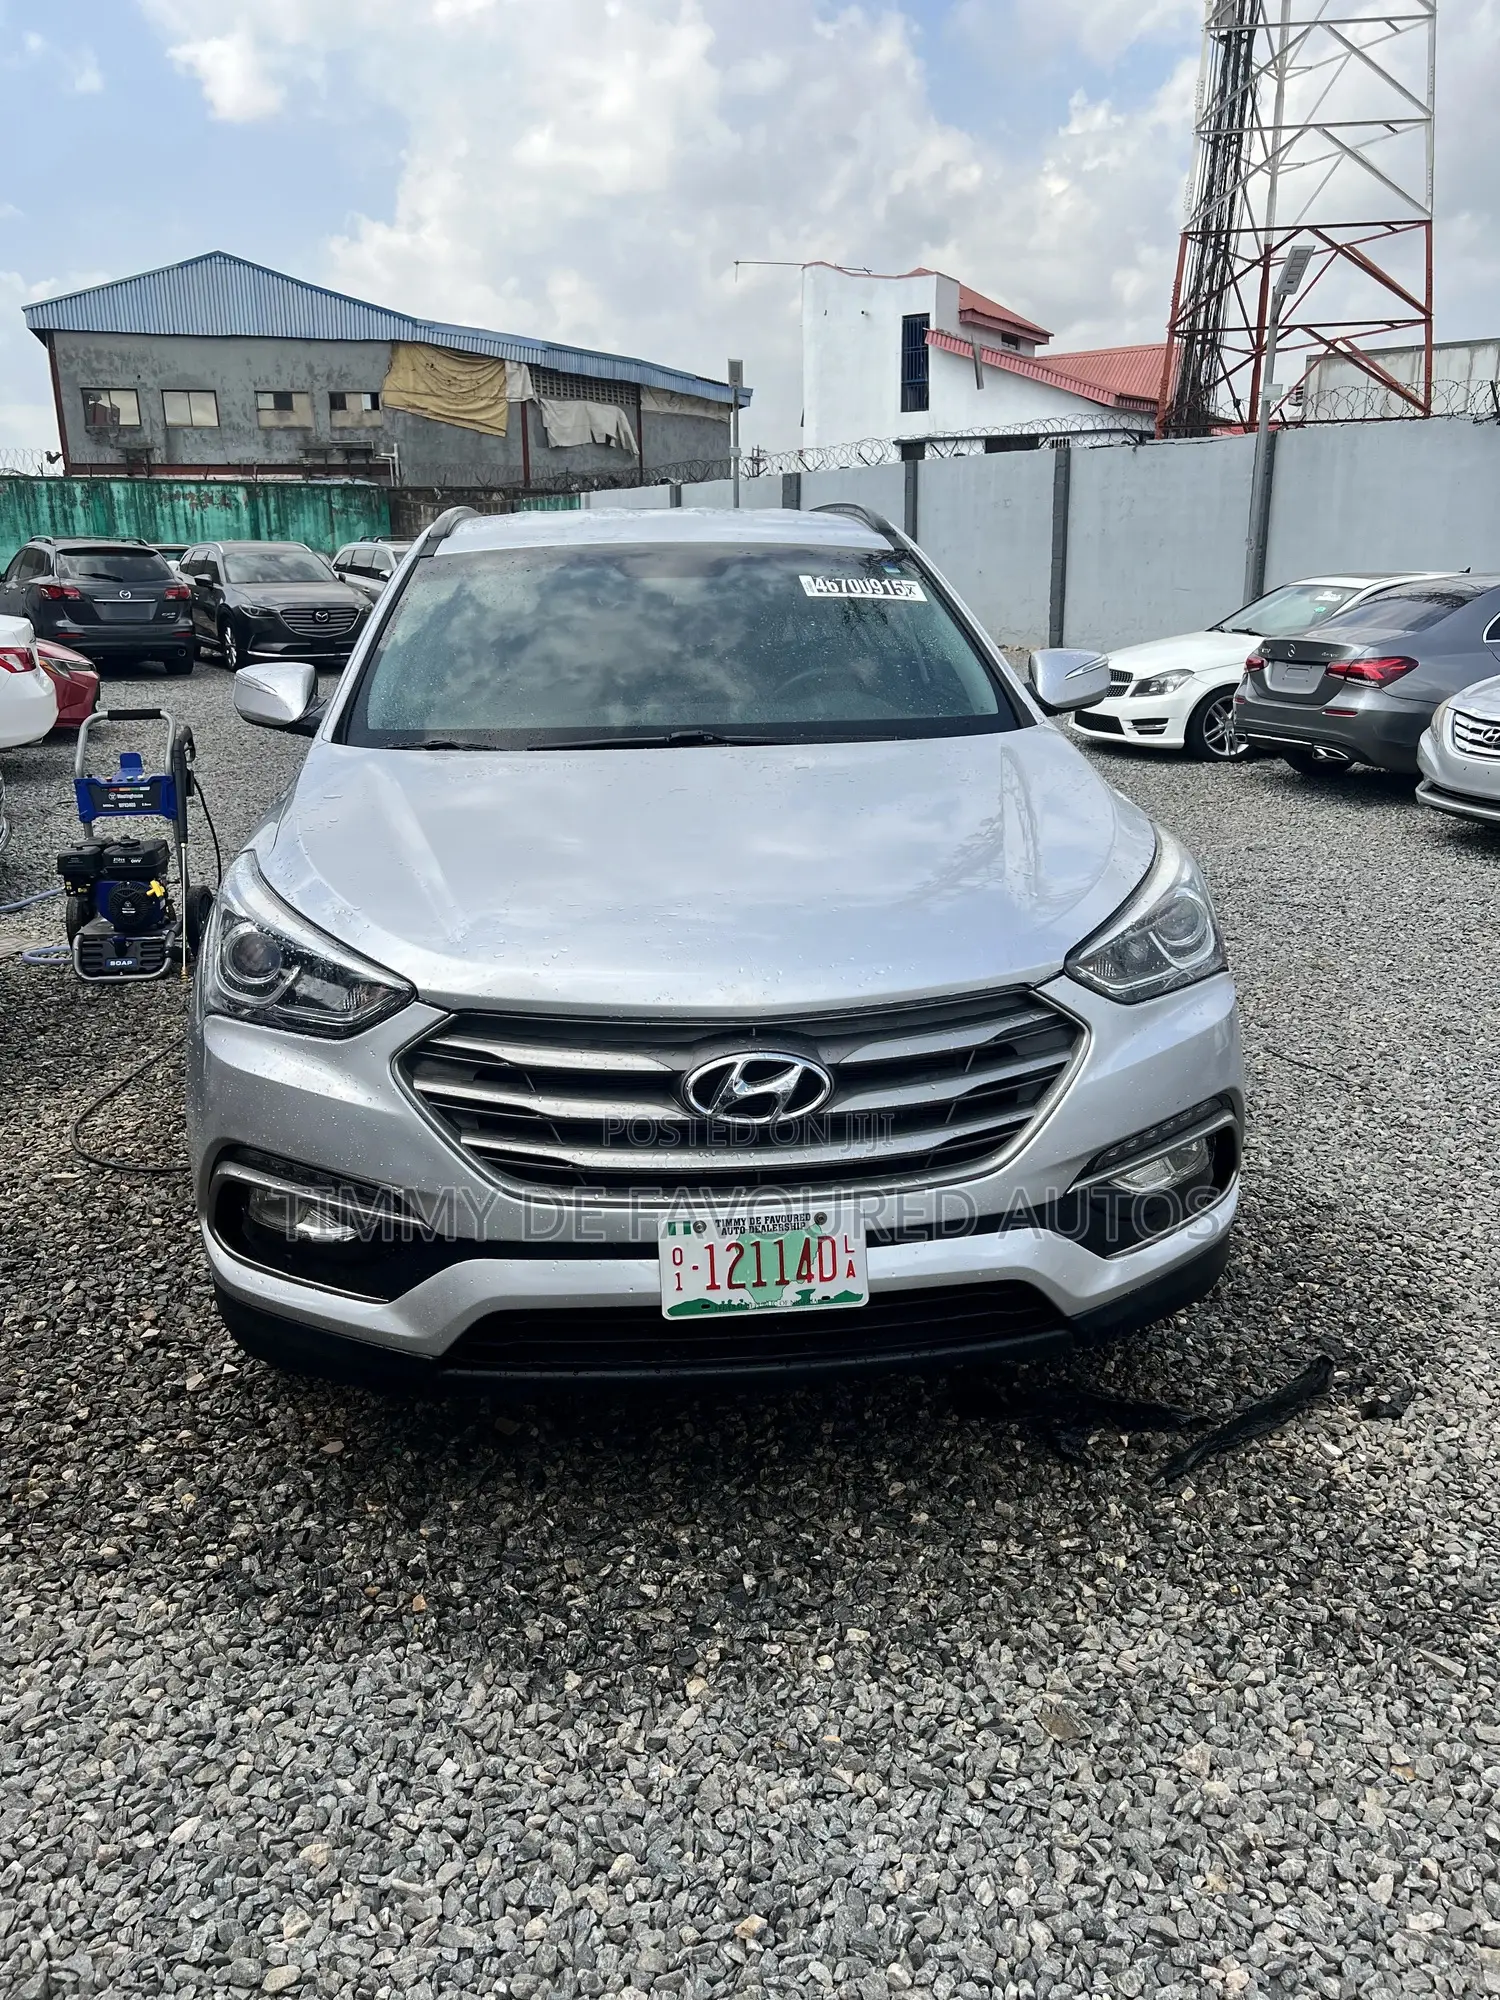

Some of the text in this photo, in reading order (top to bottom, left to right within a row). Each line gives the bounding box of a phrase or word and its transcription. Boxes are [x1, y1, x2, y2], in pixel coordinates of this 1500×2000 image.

[715, 1213, 811, 1228] TIMMY DE FAVOURED
[721, 1222, 807, 1236] AUTO DEALERSHIP
